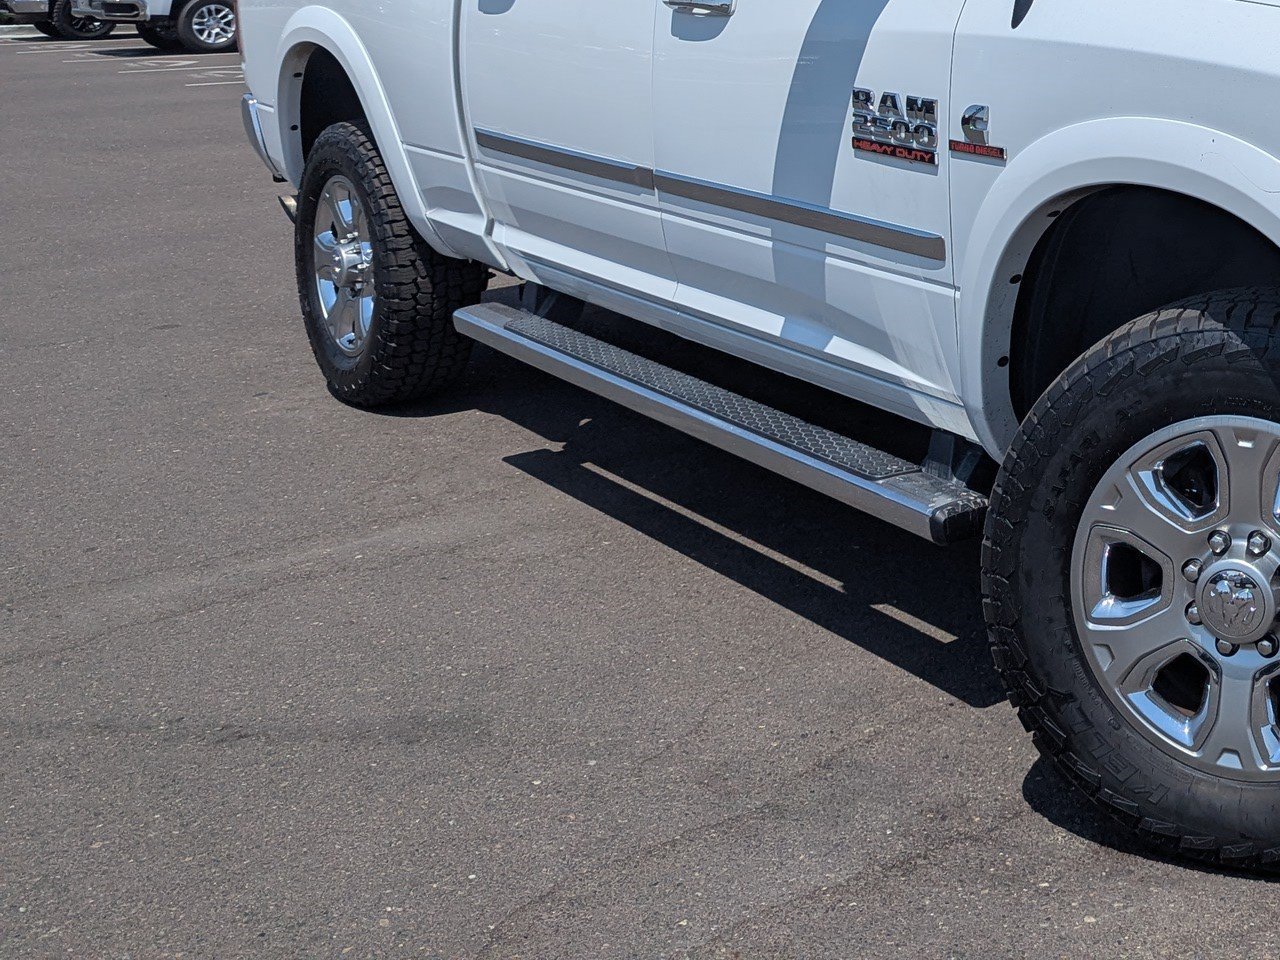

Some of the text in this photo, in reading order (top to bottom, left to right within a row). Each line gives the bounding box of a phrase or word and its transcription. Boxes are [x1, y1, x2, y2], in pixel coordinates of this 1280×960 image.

[852, 87, 938, 123] RAM
[852, 111, 938, 150] 2500
[853, 139, 933, 162] HEAVY DUTY
[950, 143, 1001, 158] TURBO DIESEL
